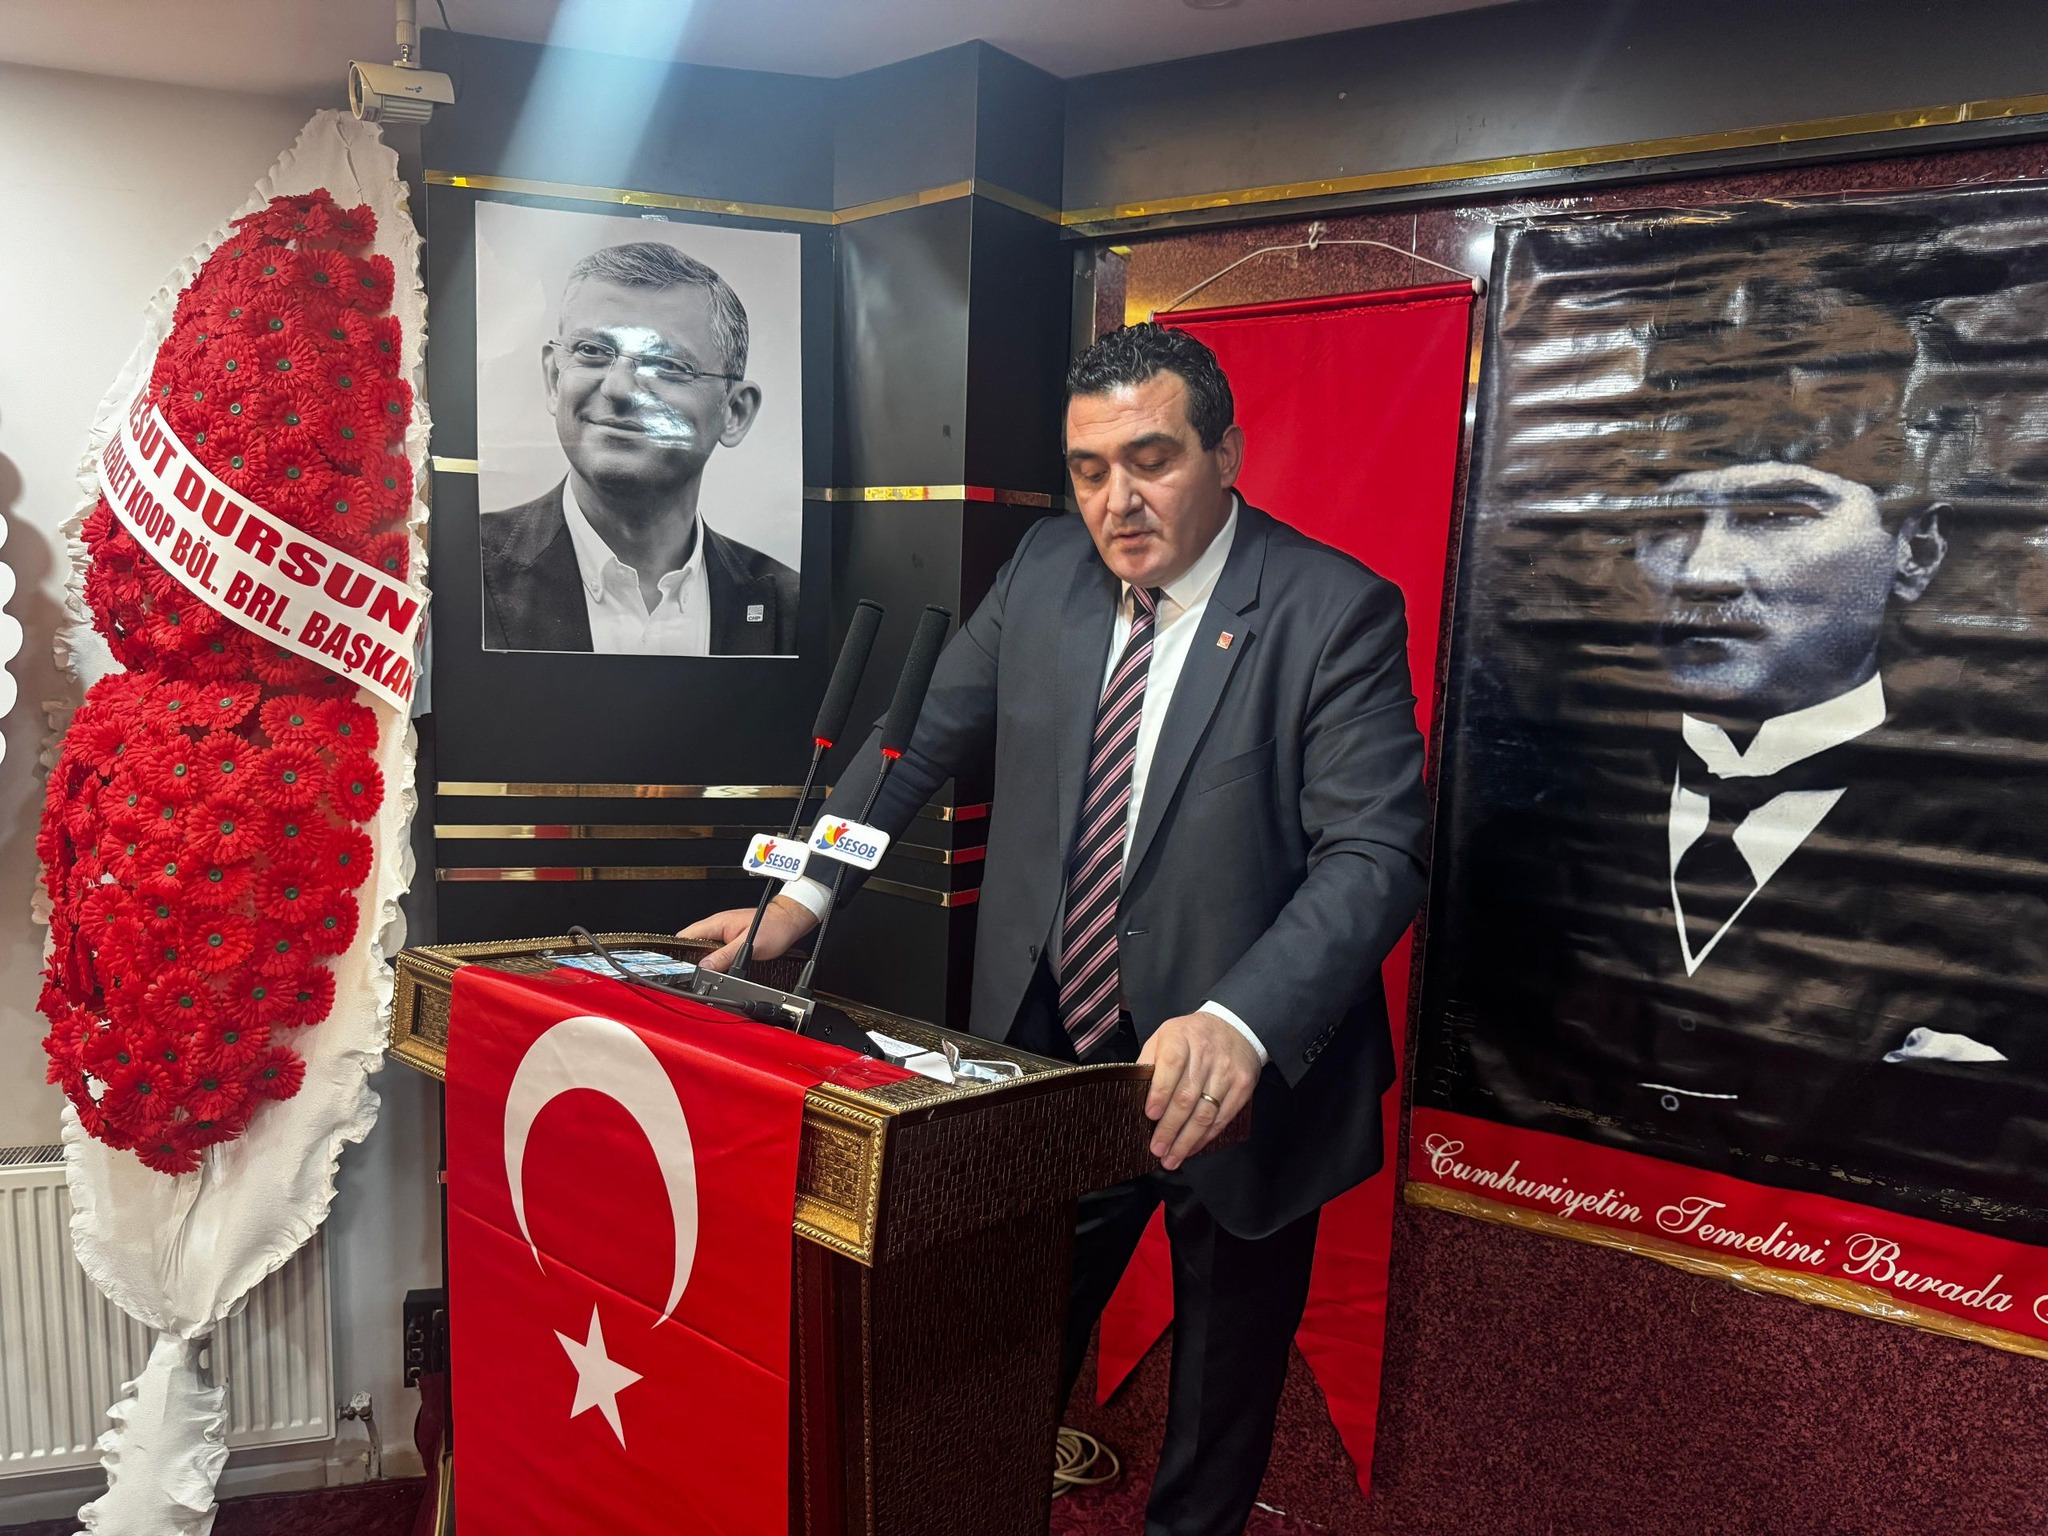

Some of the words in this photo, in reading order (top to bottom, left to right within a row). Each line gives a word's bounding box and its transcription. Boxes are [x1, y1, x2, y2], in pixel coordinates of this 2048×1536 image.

[124, 479, 176, 547] KOOP
[170, 531, 219, 595] BÖL.
[223, 569, 291, 636] BRL.
[173, 463, 419, 635] DURSUN
[766, 853, 801, 871] SESOB
[836, 836, 877, 858] SESOB
[1424, 1133, 1643, 1222] Cumhuriyetin
[1655, 1196, 1828, 1266] Temelini
[1842, 1232, 2014, 1312] Burada
